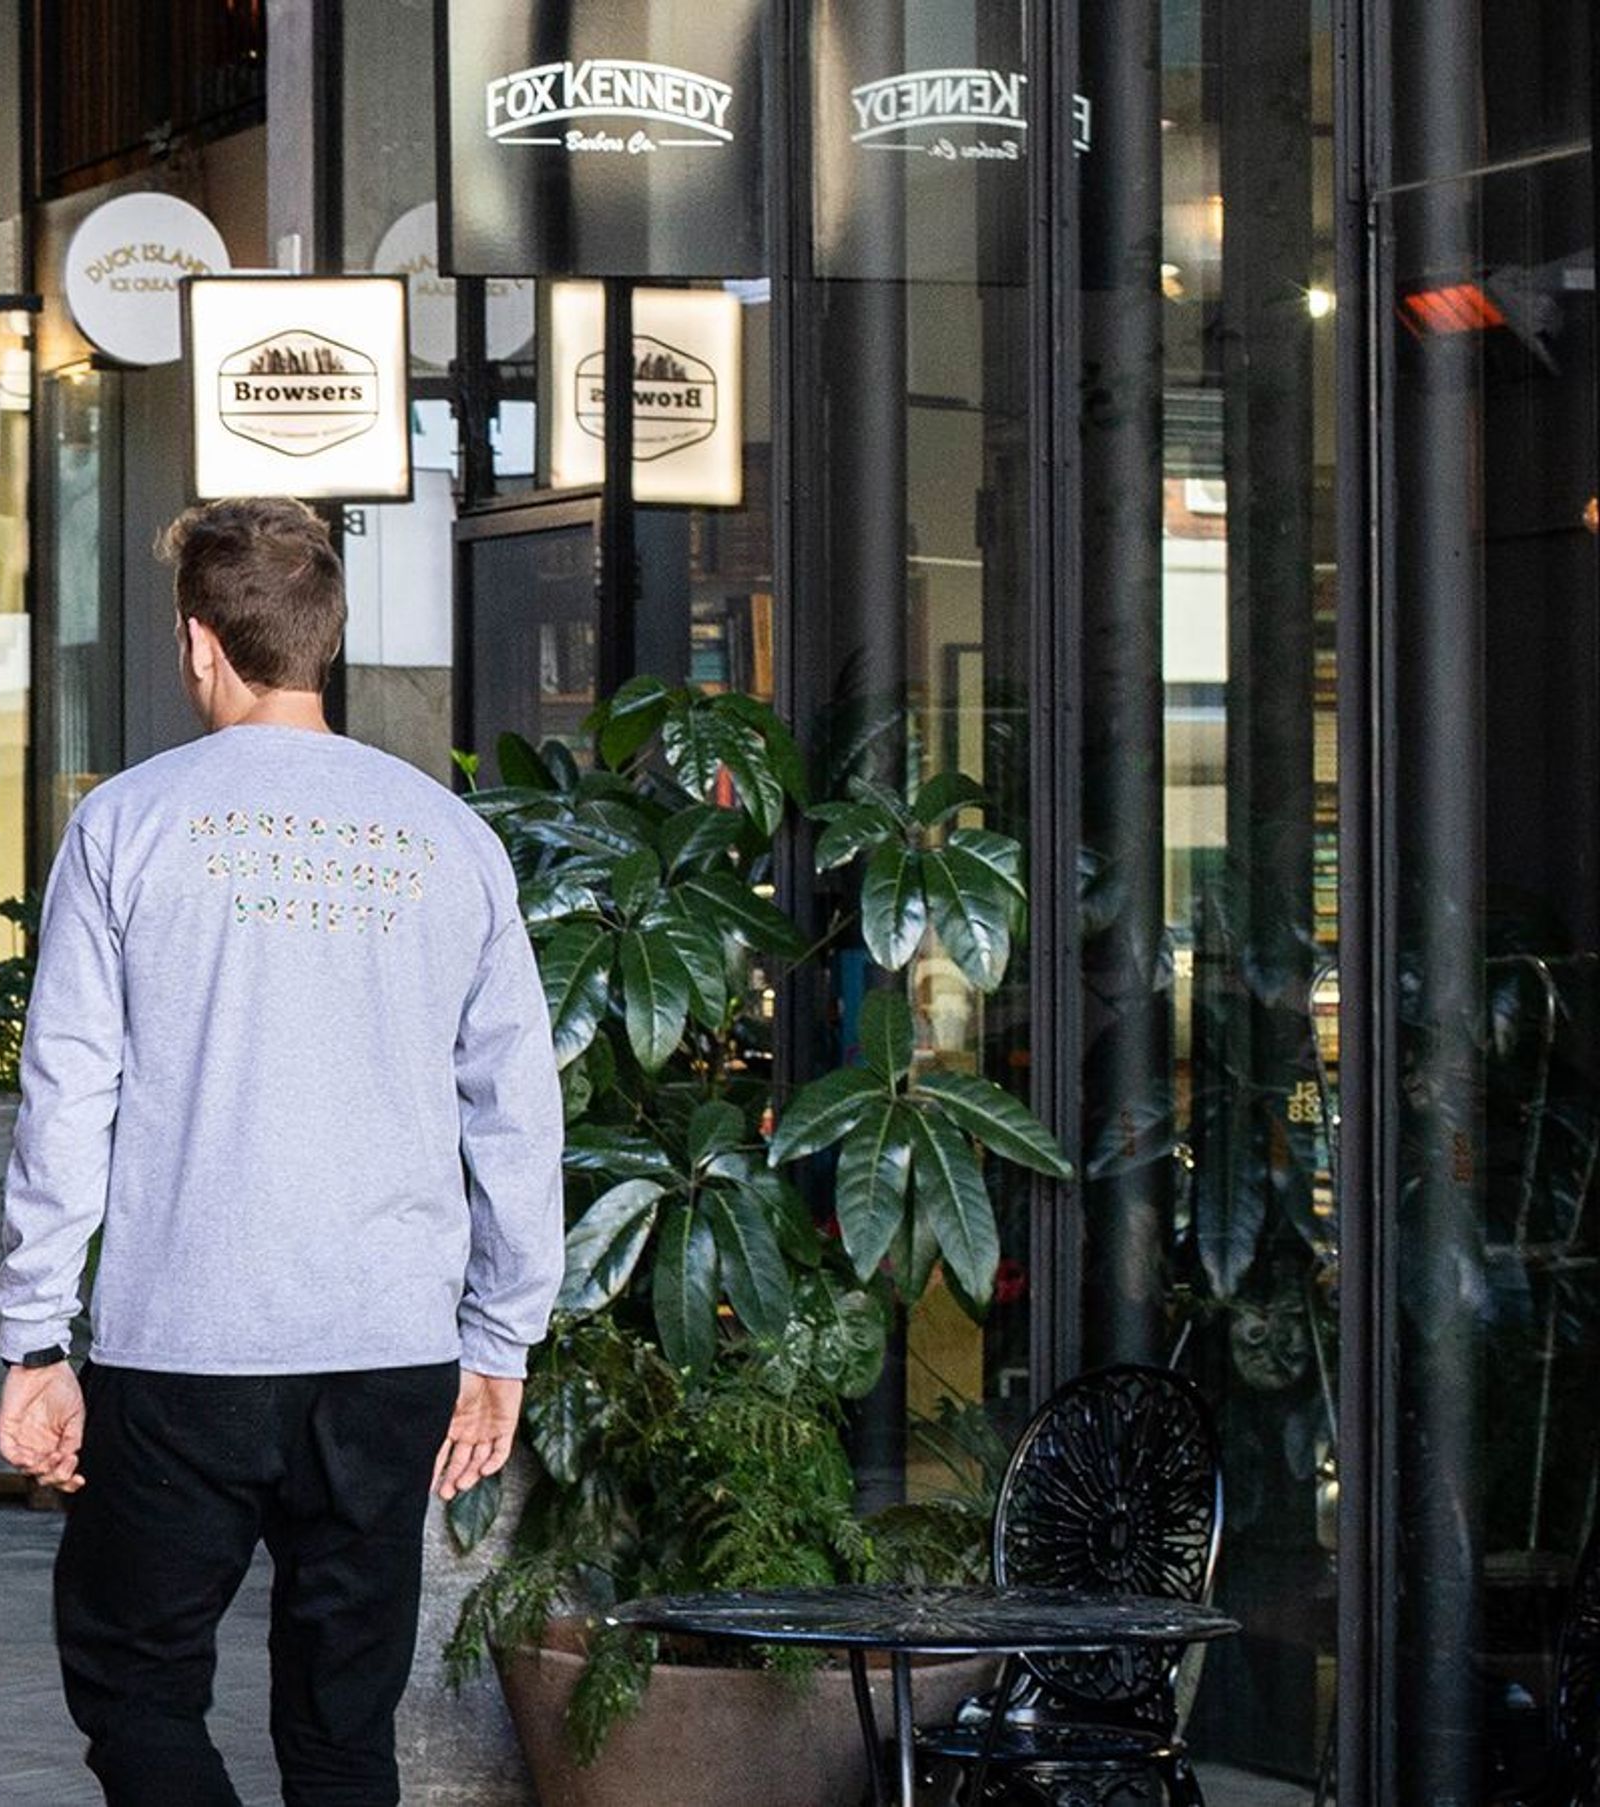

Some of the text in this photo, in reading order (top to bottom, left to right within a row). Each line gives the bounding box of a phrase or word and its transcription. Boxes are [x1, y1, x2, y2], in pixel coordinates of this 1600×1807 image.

[486, 60, 732, 129] FOX KENNEDY
[565, 130, 657, 154] Barbers Co.
[84, 243, 139, 284] DUCK
[233, 381, 363, 402] Browsers
[206, 850, 423, 901] OUTDOORS
[233, 893, 397, 935] SOCIETY
